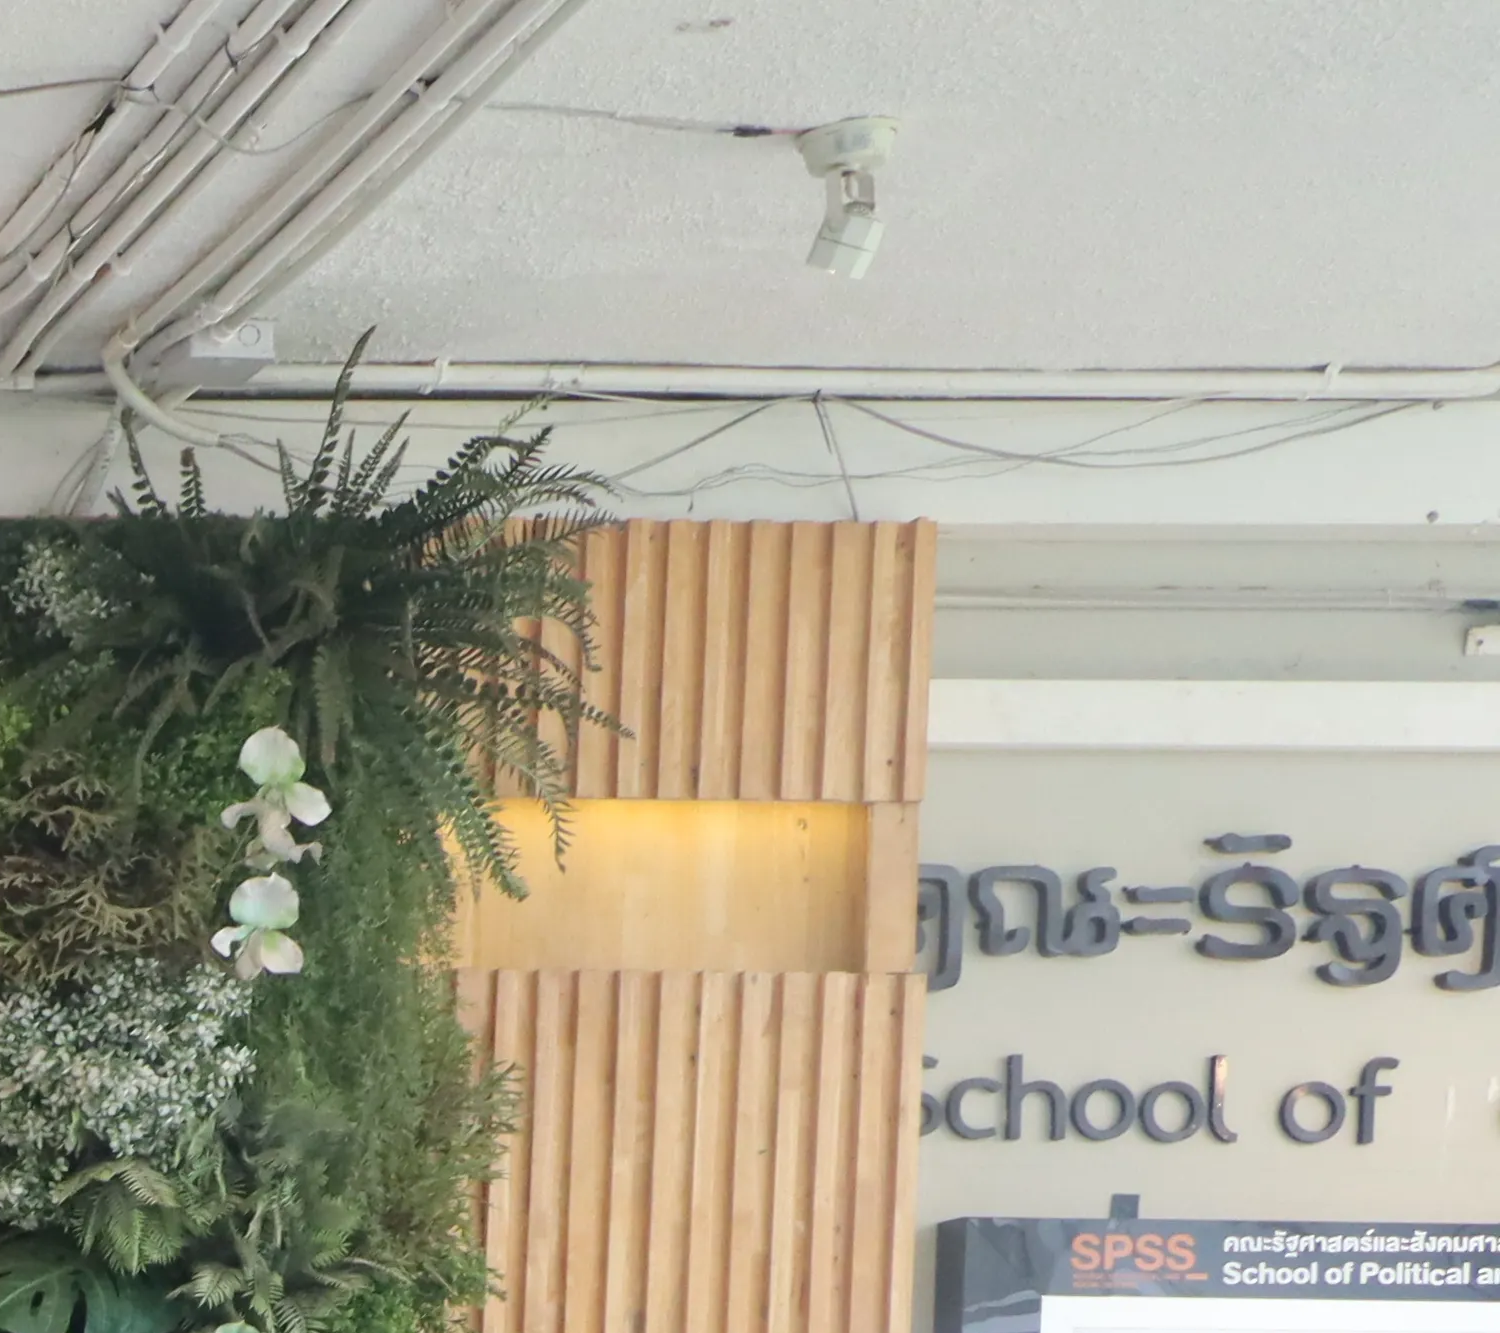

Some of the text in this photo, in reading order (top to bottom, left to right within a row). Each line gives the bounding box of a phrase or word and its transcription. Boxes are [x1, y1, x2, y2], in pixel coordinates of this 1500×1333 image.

[1279, 1056, 1400, 1145] of
[1070, 1232, 1196, 1271] SPSS
[1223, 1228, 1500, 1258] คณะรัฐศาสตร์และสังคมศา
[1222, 1261, 1319, 1286] School
[1324, 1261, 1354, 1285] of
[1360, 1261, 1471, 1286] Political
